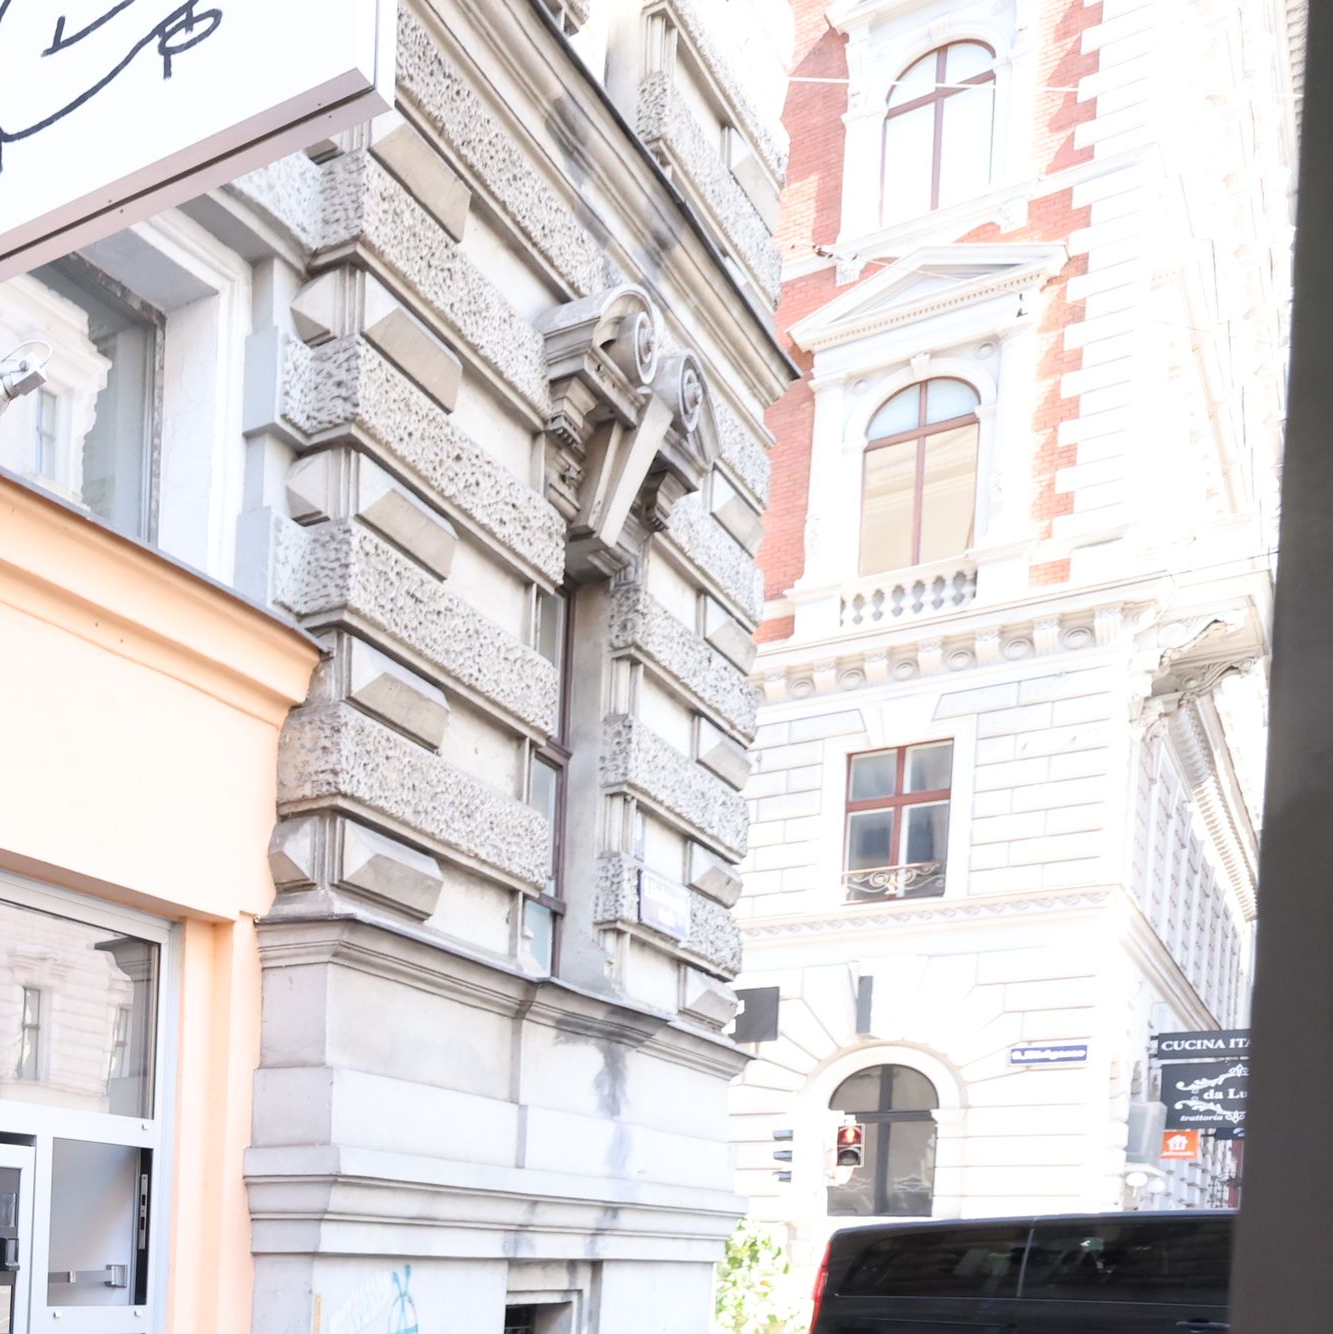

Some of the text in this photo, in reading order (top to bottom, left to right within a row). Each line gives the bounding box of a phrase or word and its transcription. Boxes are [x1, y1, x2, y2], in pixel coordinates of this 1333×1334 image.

[1160, 1038, 1226, 1052] CUCINA
[1202, 1088, 1224, 1100] da
[1179, 1113, 1224, 1123] trattoria
